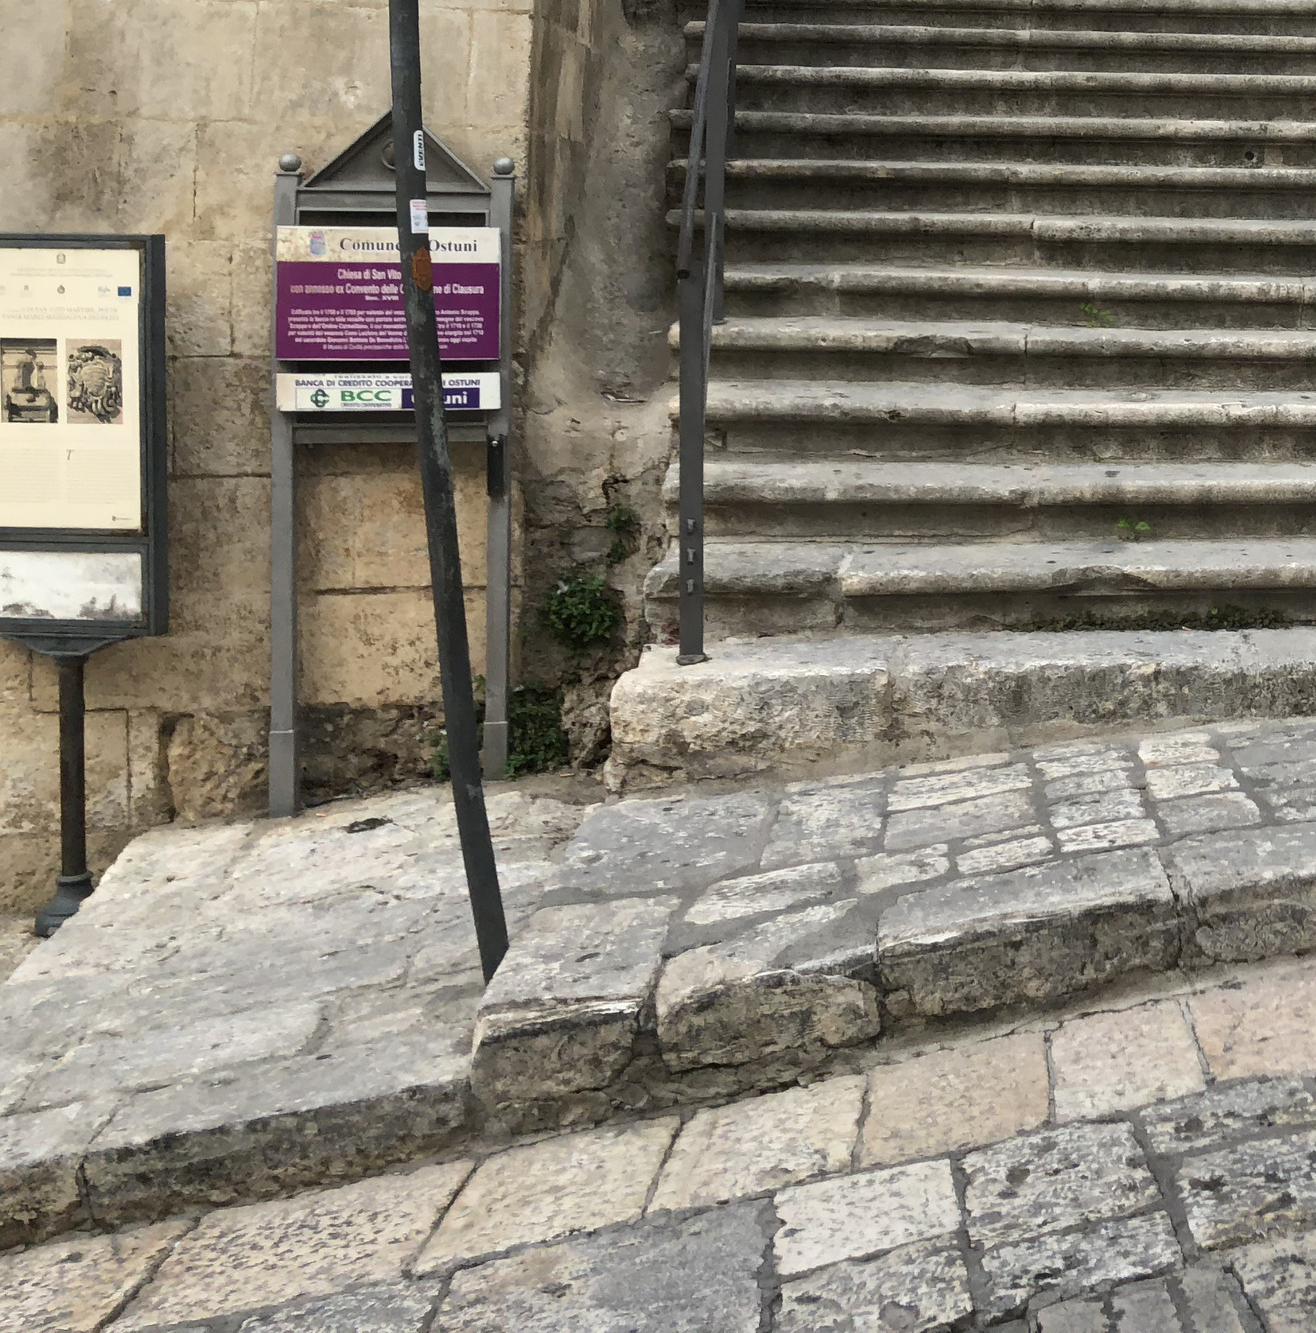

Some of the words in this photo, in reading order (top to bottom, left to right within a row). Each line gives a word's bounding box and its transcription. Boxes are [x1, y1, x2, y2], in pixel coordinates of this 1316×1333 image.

[428, 238, 478, 253] Ostuni
[337, 268, 362, 280] Chiesa
[363, 268, 371, 280] di
[372, 268, 386, 280] San
[387, 268, 402, 280] Vito
[345, 283, 380, 294] Convento
[380, 283, 399, 294] delle
[443, 283, 451, 294] di
[452, 283, 485, 294] Clausura
[295, 379, 324, 387] BANCA
[326, 379, 335, 387] DI
[338, 379, 372, 387] CREDITO
[375, 379, 413, 387] COOPERA
[340, 390, 392, 402] BCC
